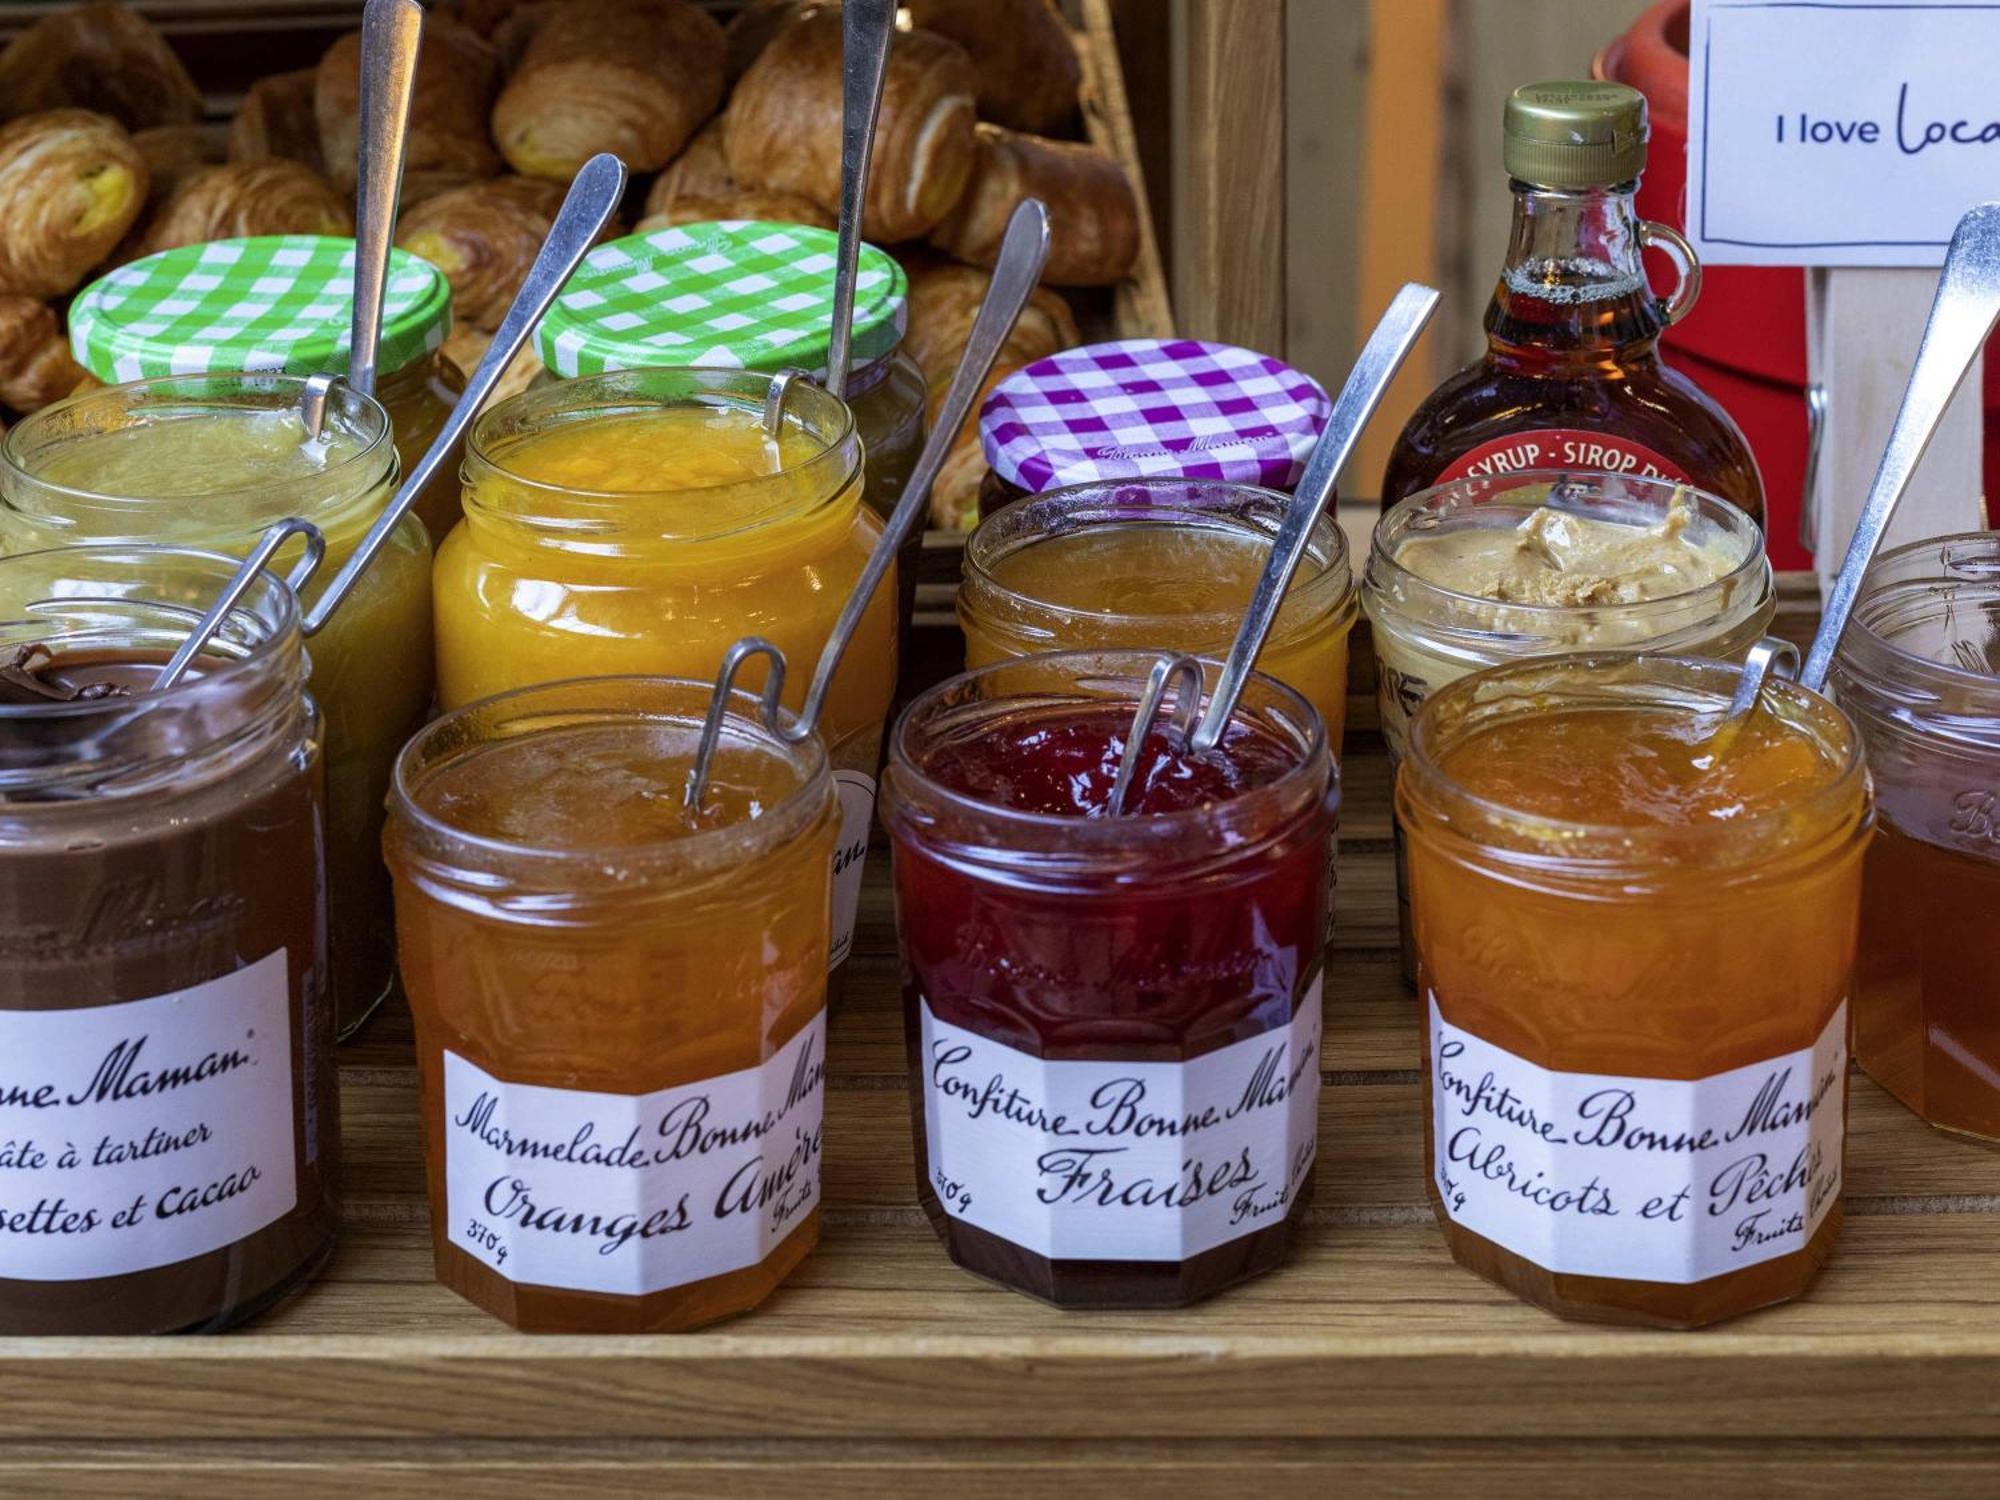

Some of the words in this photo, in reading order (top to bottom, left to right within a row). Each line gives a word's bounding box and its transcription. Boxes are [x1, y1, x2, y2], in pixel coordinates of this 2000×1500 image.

[1777, 114, 1784, 143] I
[1800, 113, 1880, 143] love
[1564, 441, 1637, 473] SIROP
[67, 1033, 250, 1107] Maman
[932, 1038, 1080, 1136] Confiture
[1086, 1078, 1221, 1138] Bonne
[1438, 1031, 1568, 1142] Confiture
[1574, 1089, 1719, 1151] Bonne
[57, 1141, 82, 1169] à
[92, 1122, 213, 1168] tartiner
[454, 1091, 651, 1170] Marmelade
[655, 1094, 776, 1164] Bonne
[111, 1195, 147, 1229] et
[155, 1165, 261, 1220] Cacao
[1037, 1146, 1260, 1209] Fraises
[1448, 1127, 1619, 1217] Abricots
[1636, 1183, 1690, 1223] et
[484, 1176, 694, 1256] Oranges
